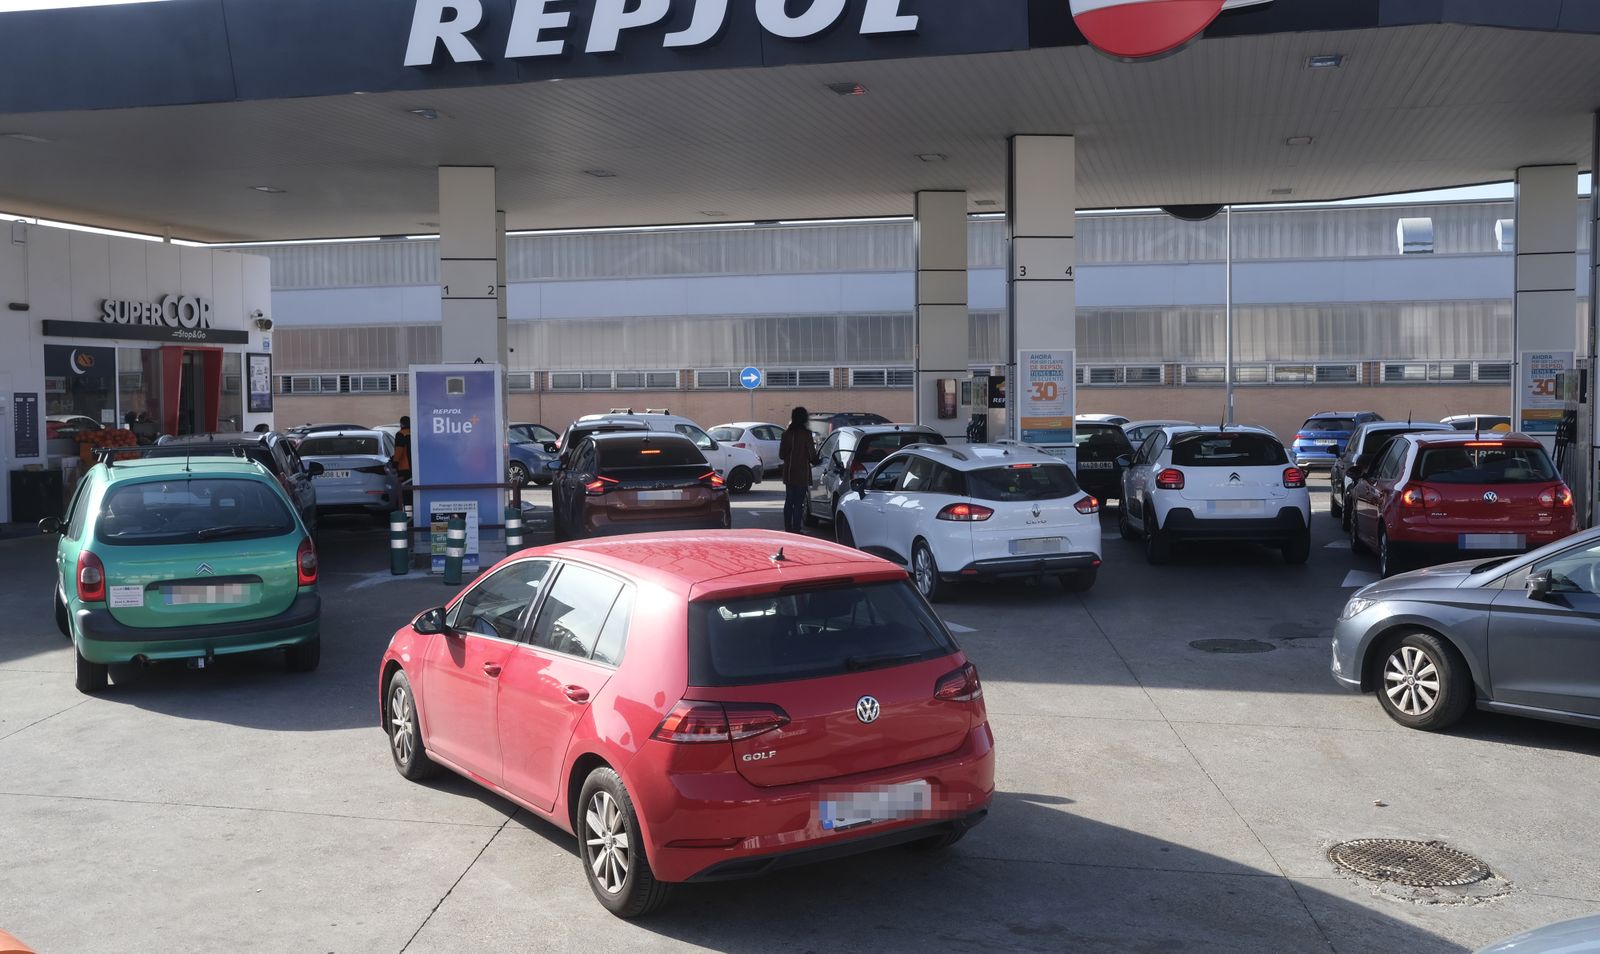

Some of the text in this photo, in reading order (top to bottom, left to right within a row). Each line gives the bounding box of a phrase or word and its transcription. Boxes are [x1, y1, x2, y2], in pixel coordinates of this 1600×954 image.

[1019, 265, 1027, 277] 3
[1065, 265, 1073, 277] 4
[443, 285, 450, 295] 1
[487, 285, 495, 296] 2
[172, 330, 206, 341] Stop&Go
[1027, 381, 1057, 400] -30
[742, 750, 777, 762] GOLF
